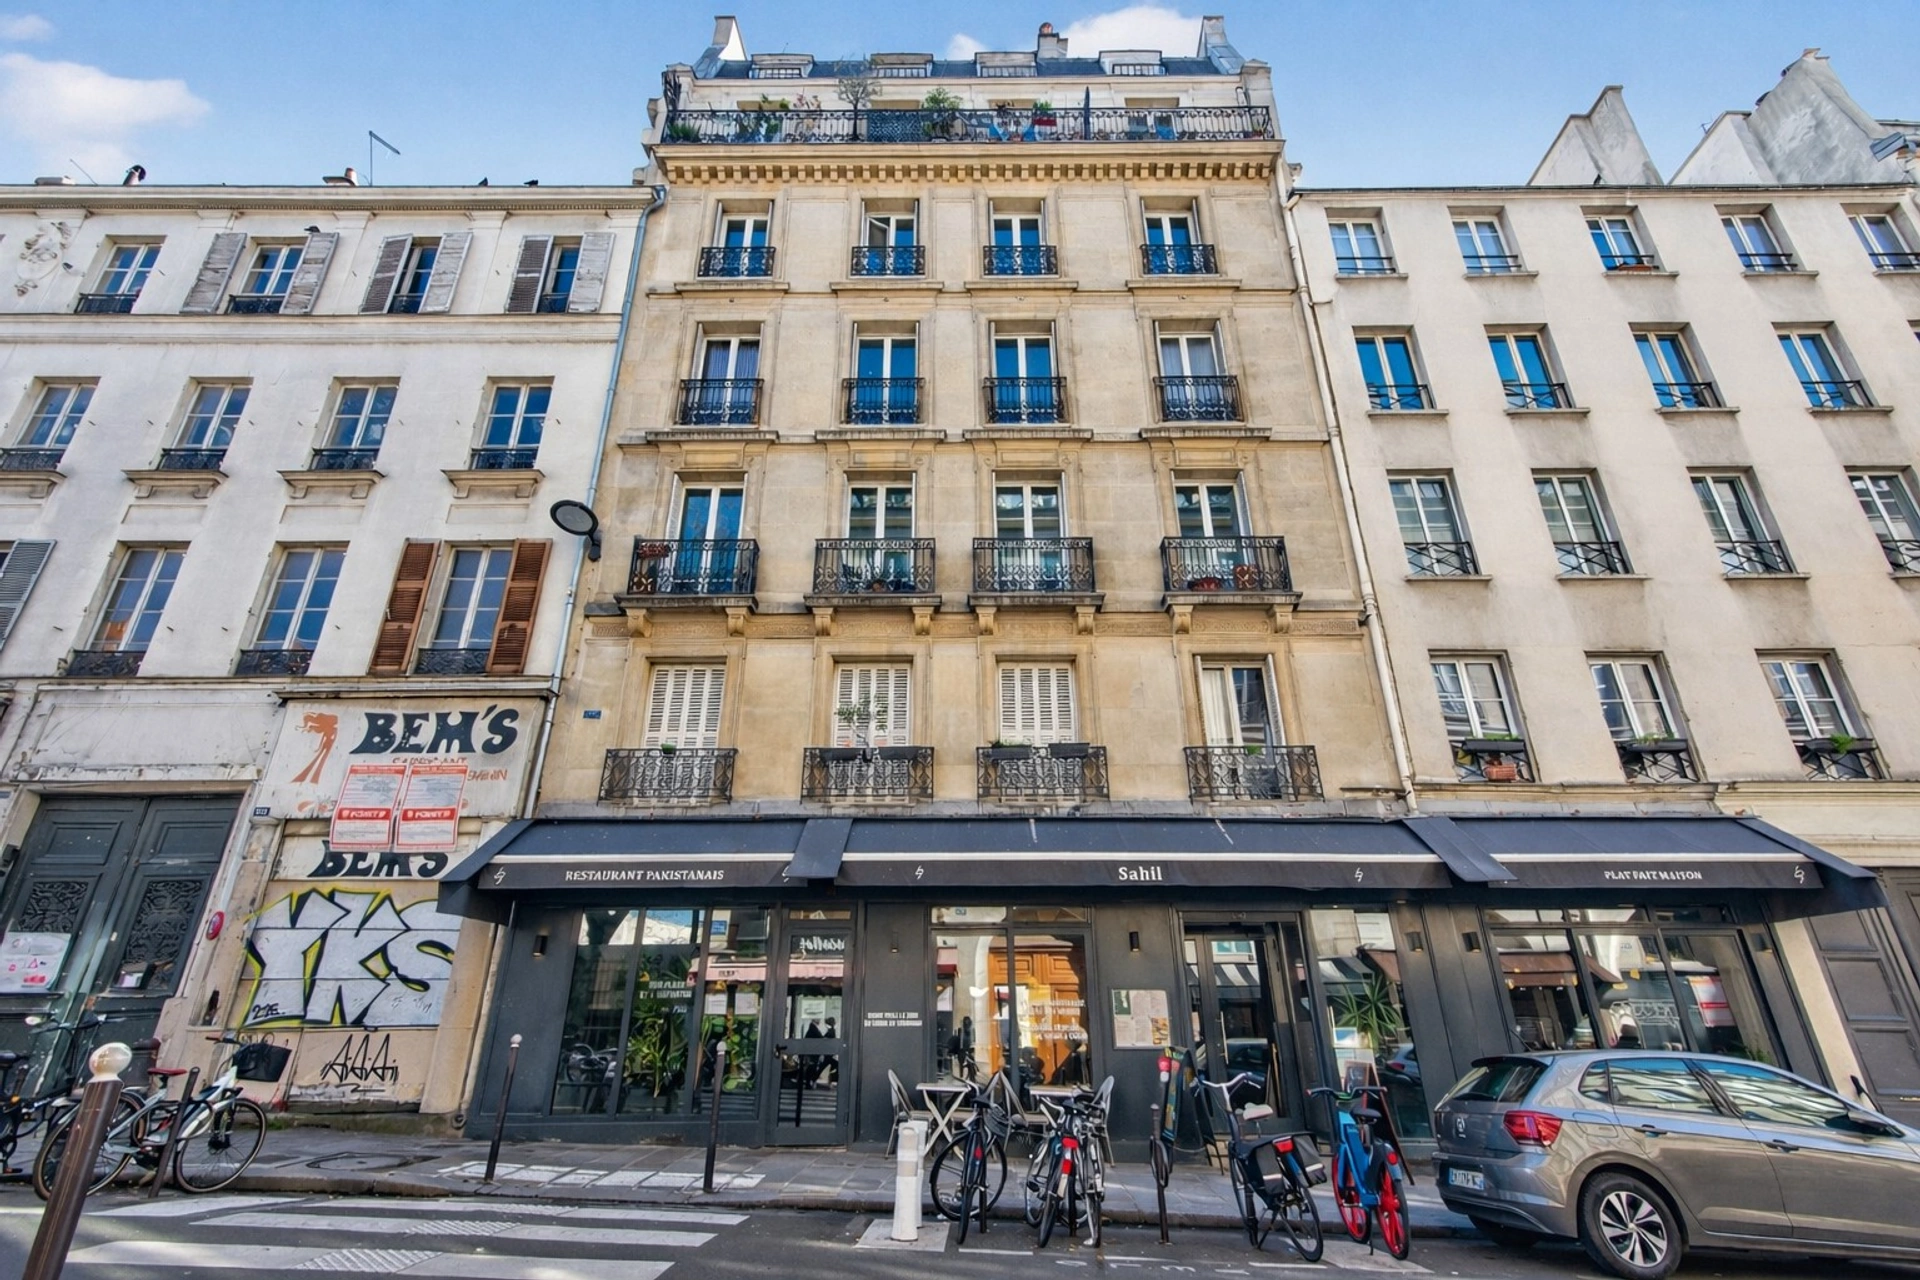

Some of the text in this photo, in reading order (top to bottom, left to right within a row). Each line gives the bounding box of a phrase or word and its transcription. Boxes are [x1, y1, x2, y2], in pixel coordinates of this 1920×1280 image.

[349, 704, 520, 755] BEM'S
[565, 870, 724, 881] RESTAURANT PAKISTANAIS
[1118, 866, 1162, 881] Sahil
